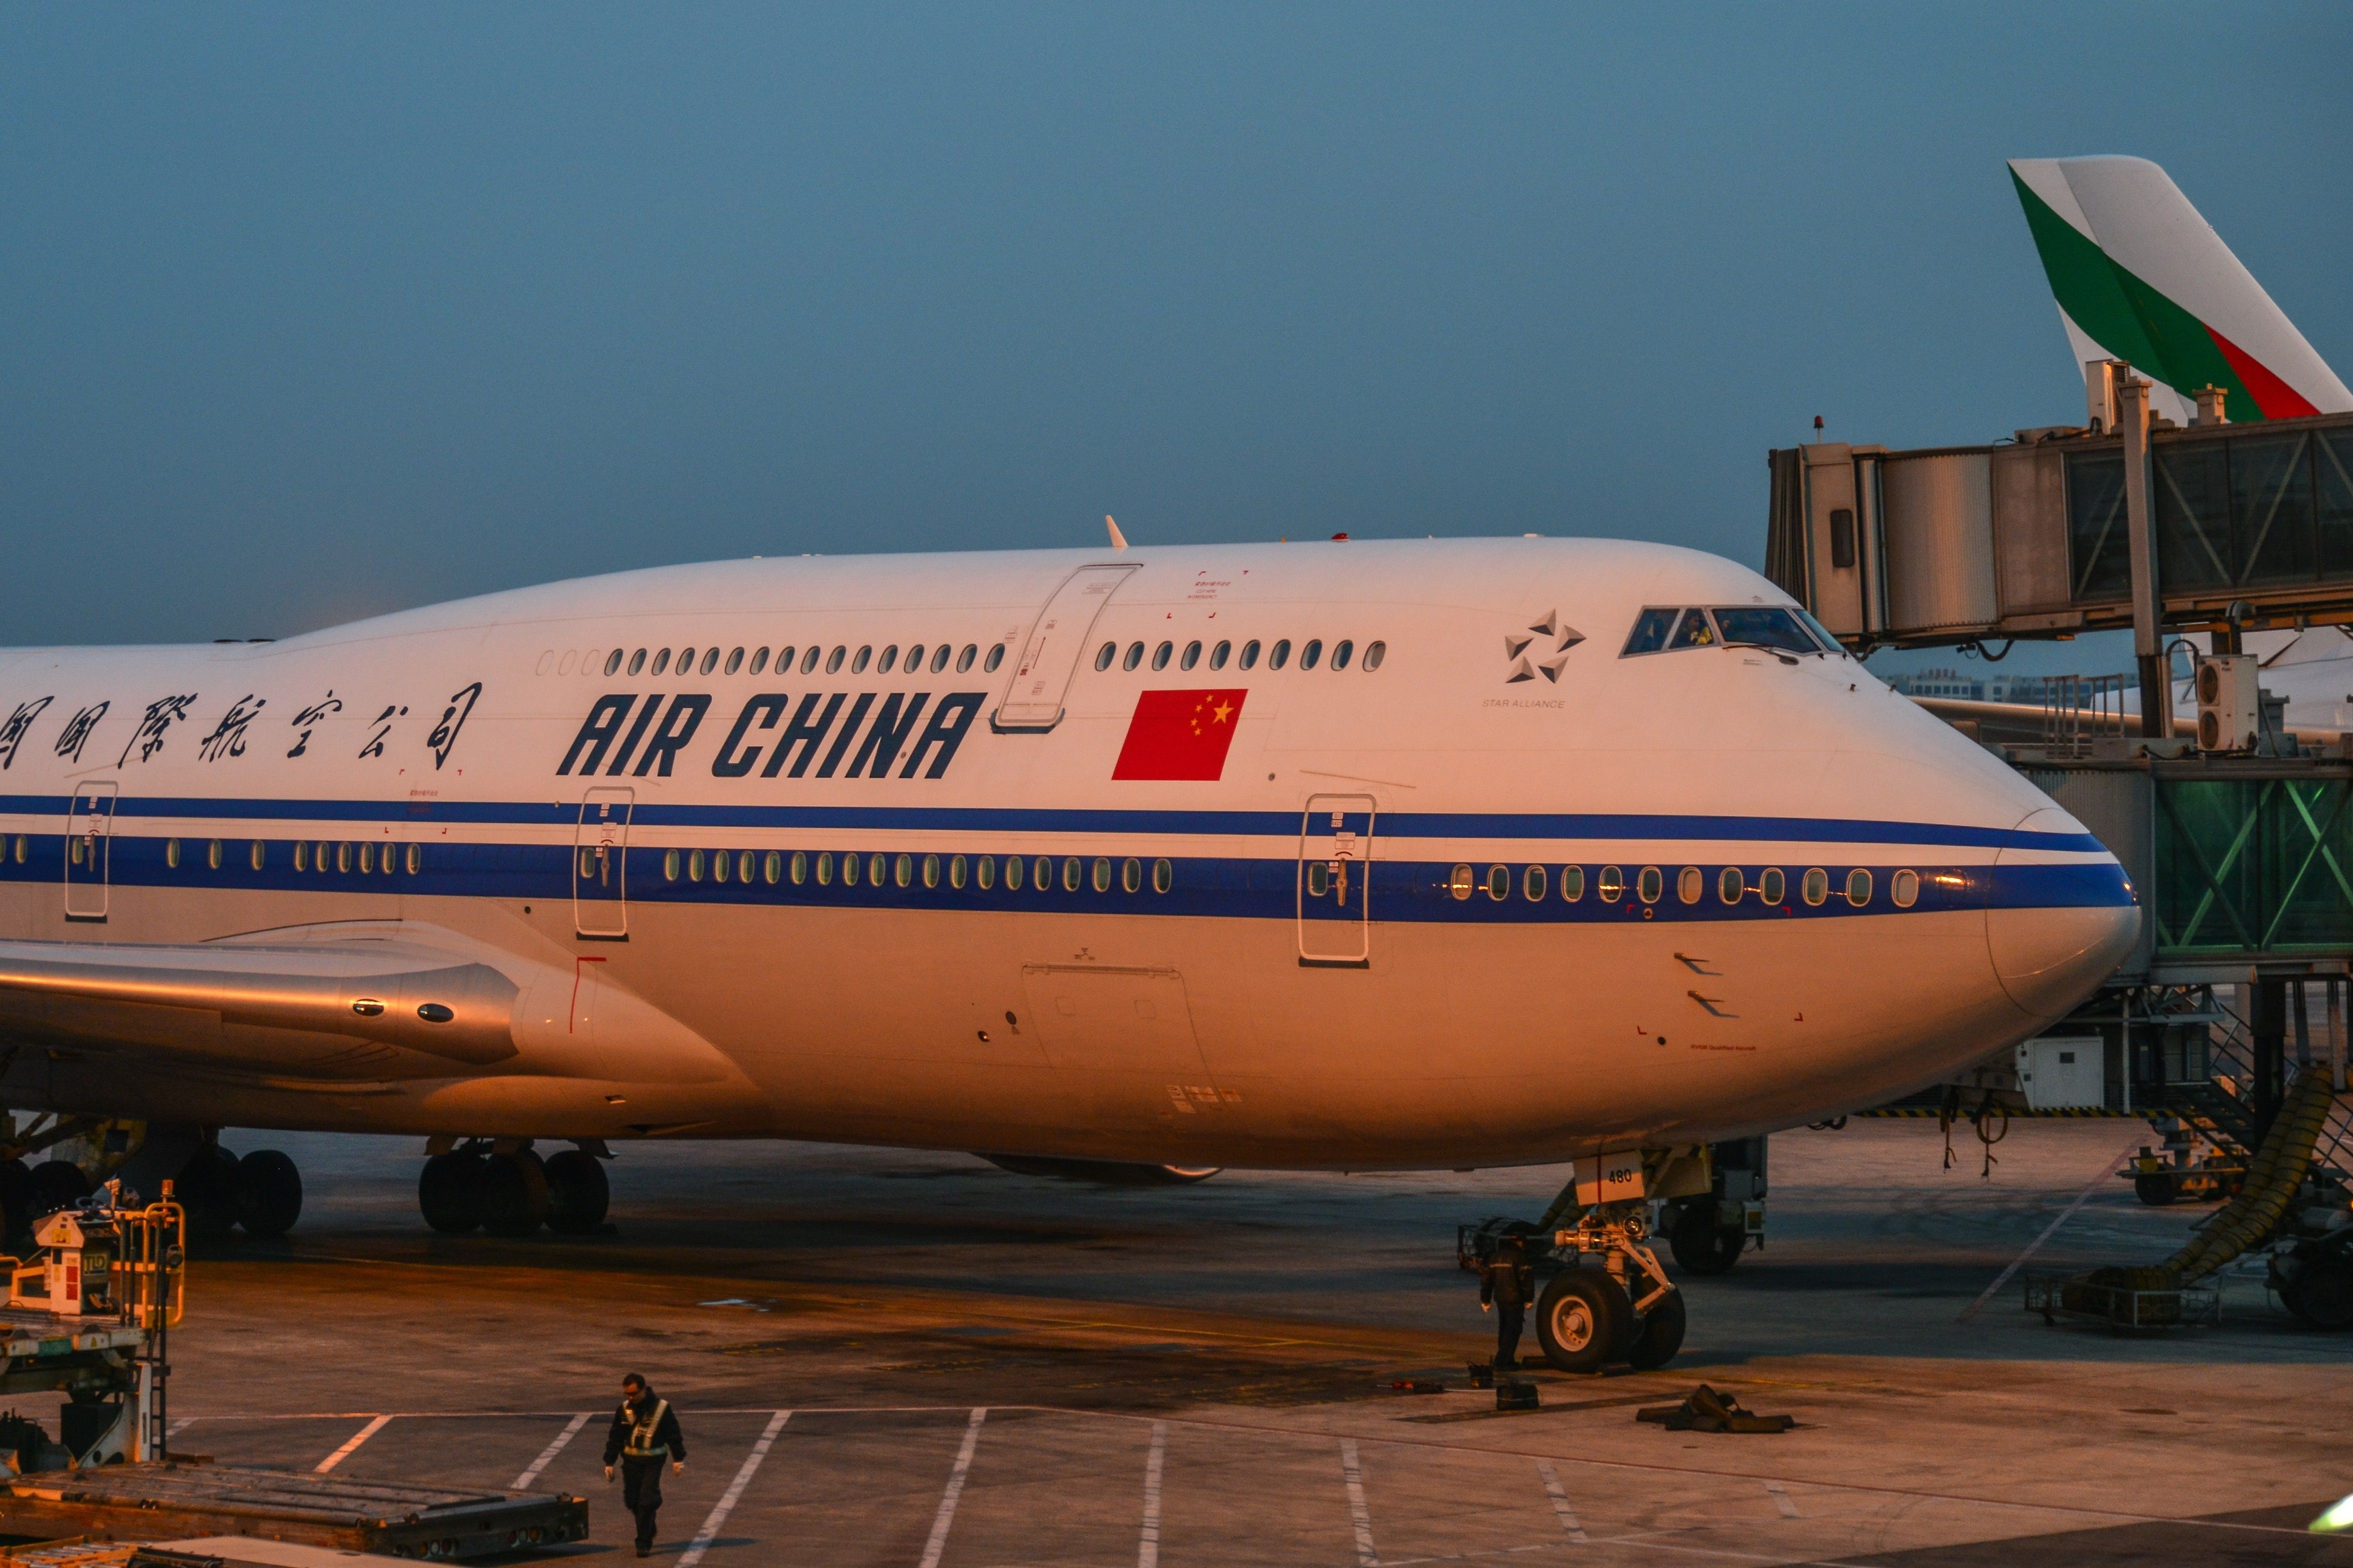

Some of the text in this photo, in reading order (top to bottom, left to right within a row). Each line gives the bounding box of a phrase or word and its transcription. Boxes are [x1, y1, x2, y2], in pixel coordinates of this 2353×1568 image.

[1512, 700, 1565, 708] ALLIANCE
[555, 692, 988, 779] AIR CHINA
[1609, 1168, 1632, 1184] 480
